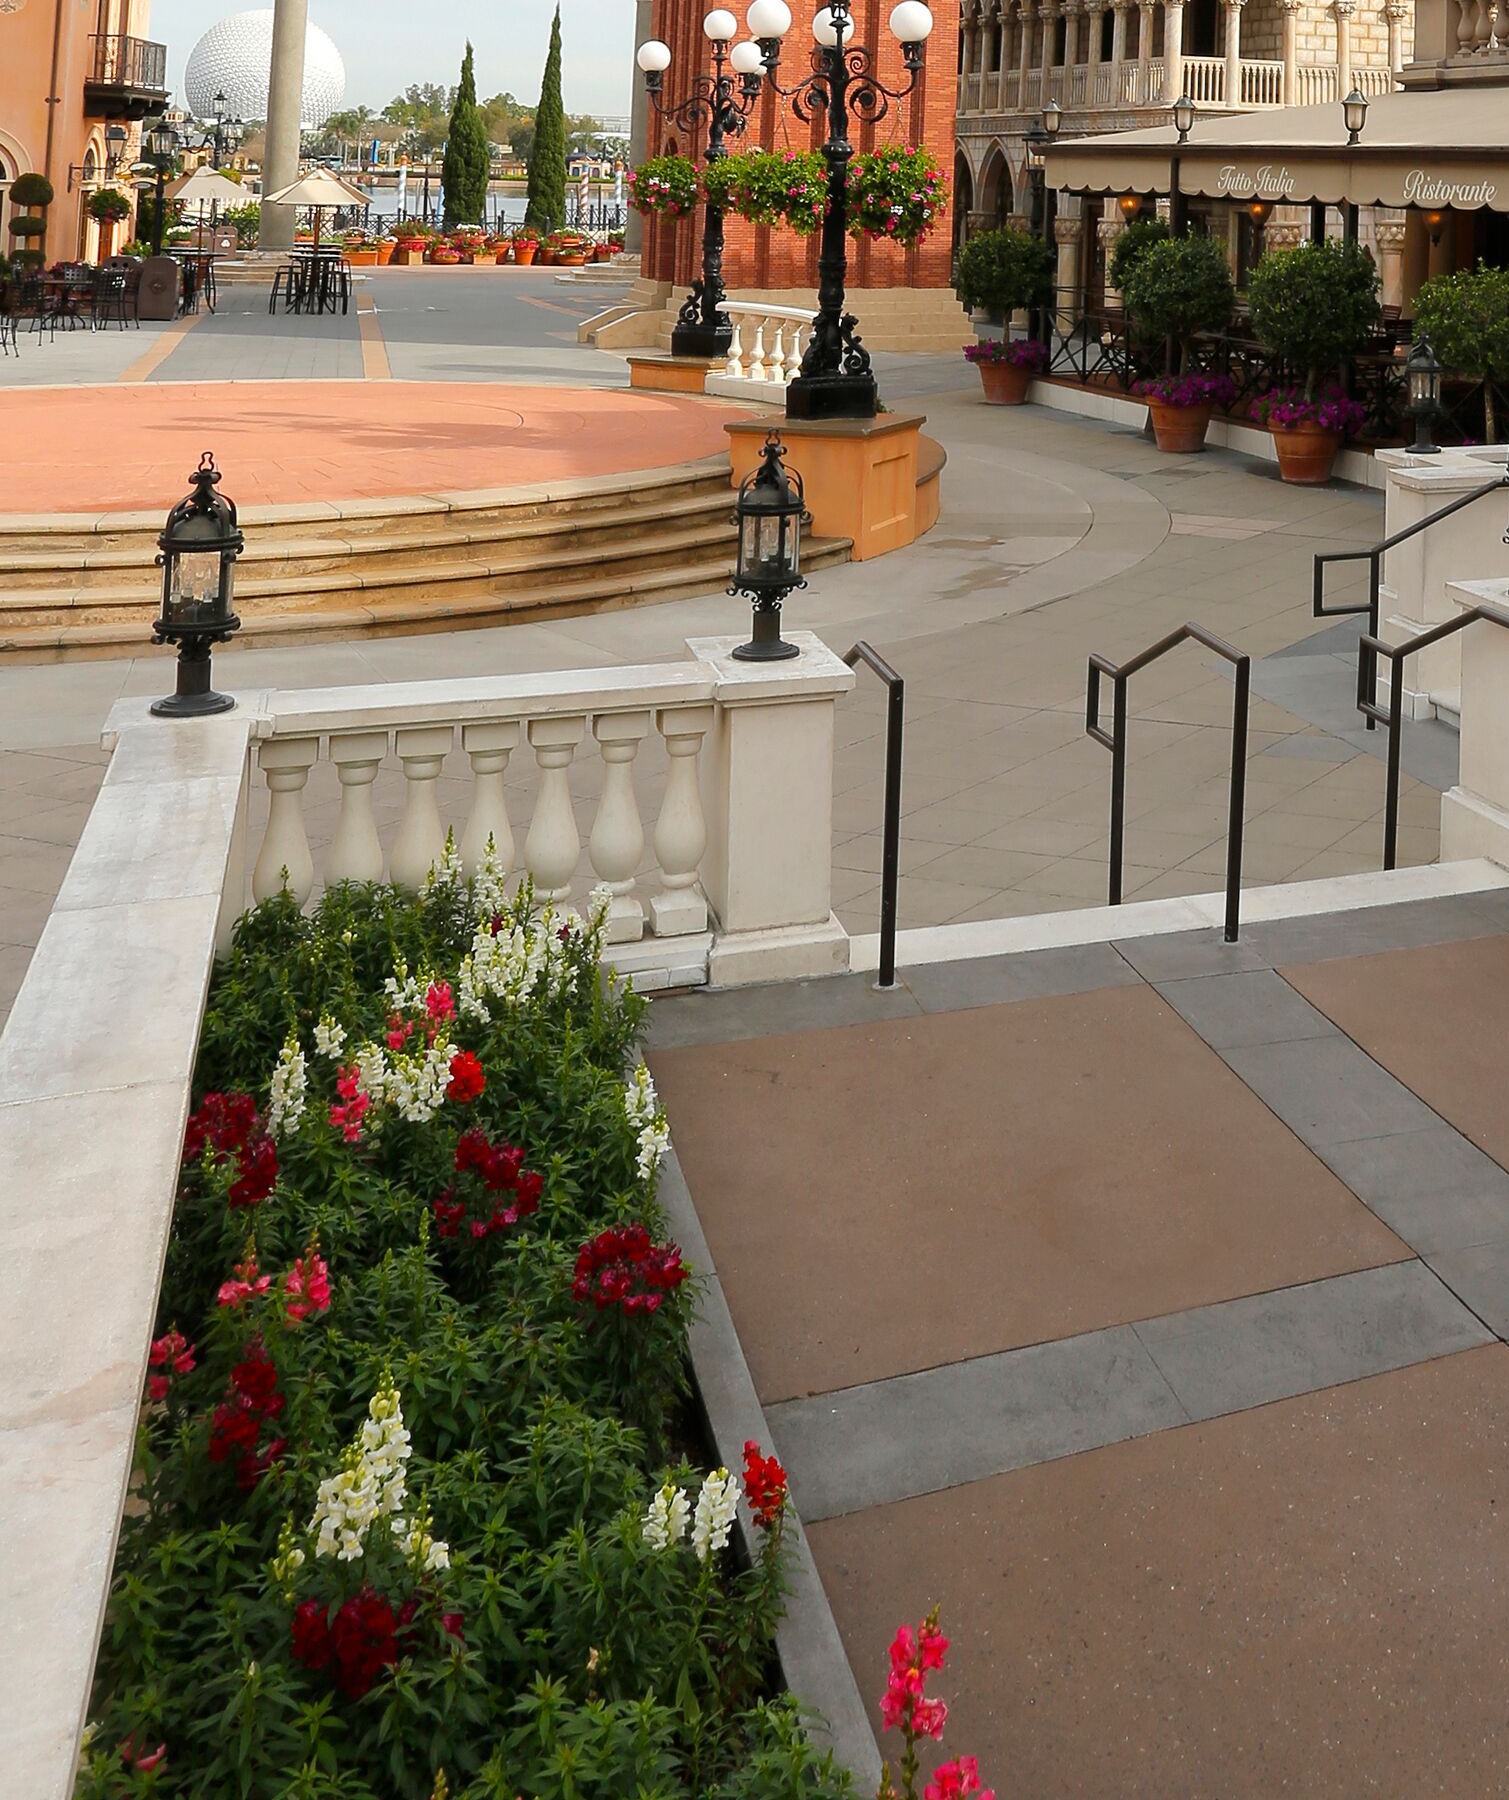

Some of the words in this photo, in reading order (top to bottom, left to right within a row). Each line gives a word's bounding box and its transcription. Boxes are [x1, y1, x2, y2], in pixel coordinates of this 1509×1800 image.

[1217, 165, 1253, 191] Tutto
[1253, 165, 1297, 193] Italia
[1403, 169, 1498, 202] Ristorante
